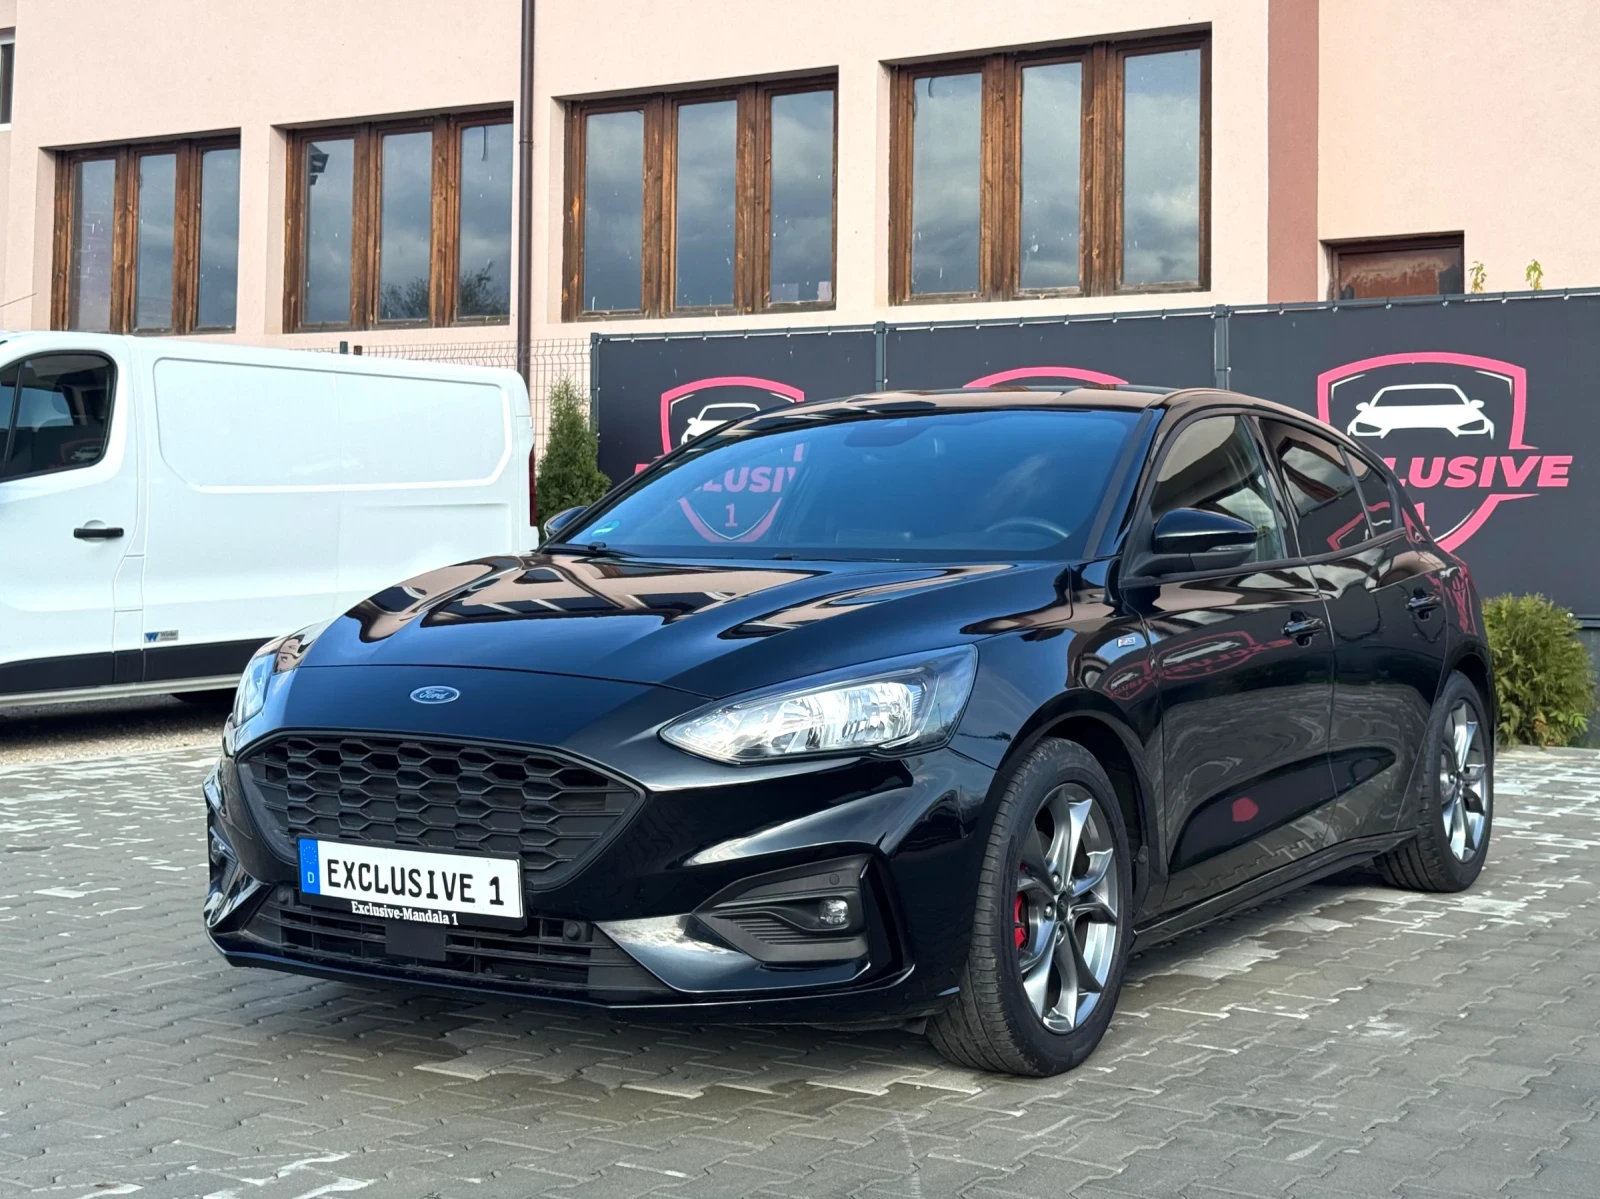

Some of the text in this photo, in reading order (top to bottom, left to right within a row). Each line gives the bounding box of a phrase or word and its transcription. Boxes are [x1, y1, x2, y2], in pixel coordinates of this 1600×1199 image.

[725, 503, 738, 527] 1
[307, 871, 315, 884] D
[327, 858, 505, 906] EXCLUSIVE 1
[351, 900, 459, 926] Exclusive-Mandala 1
